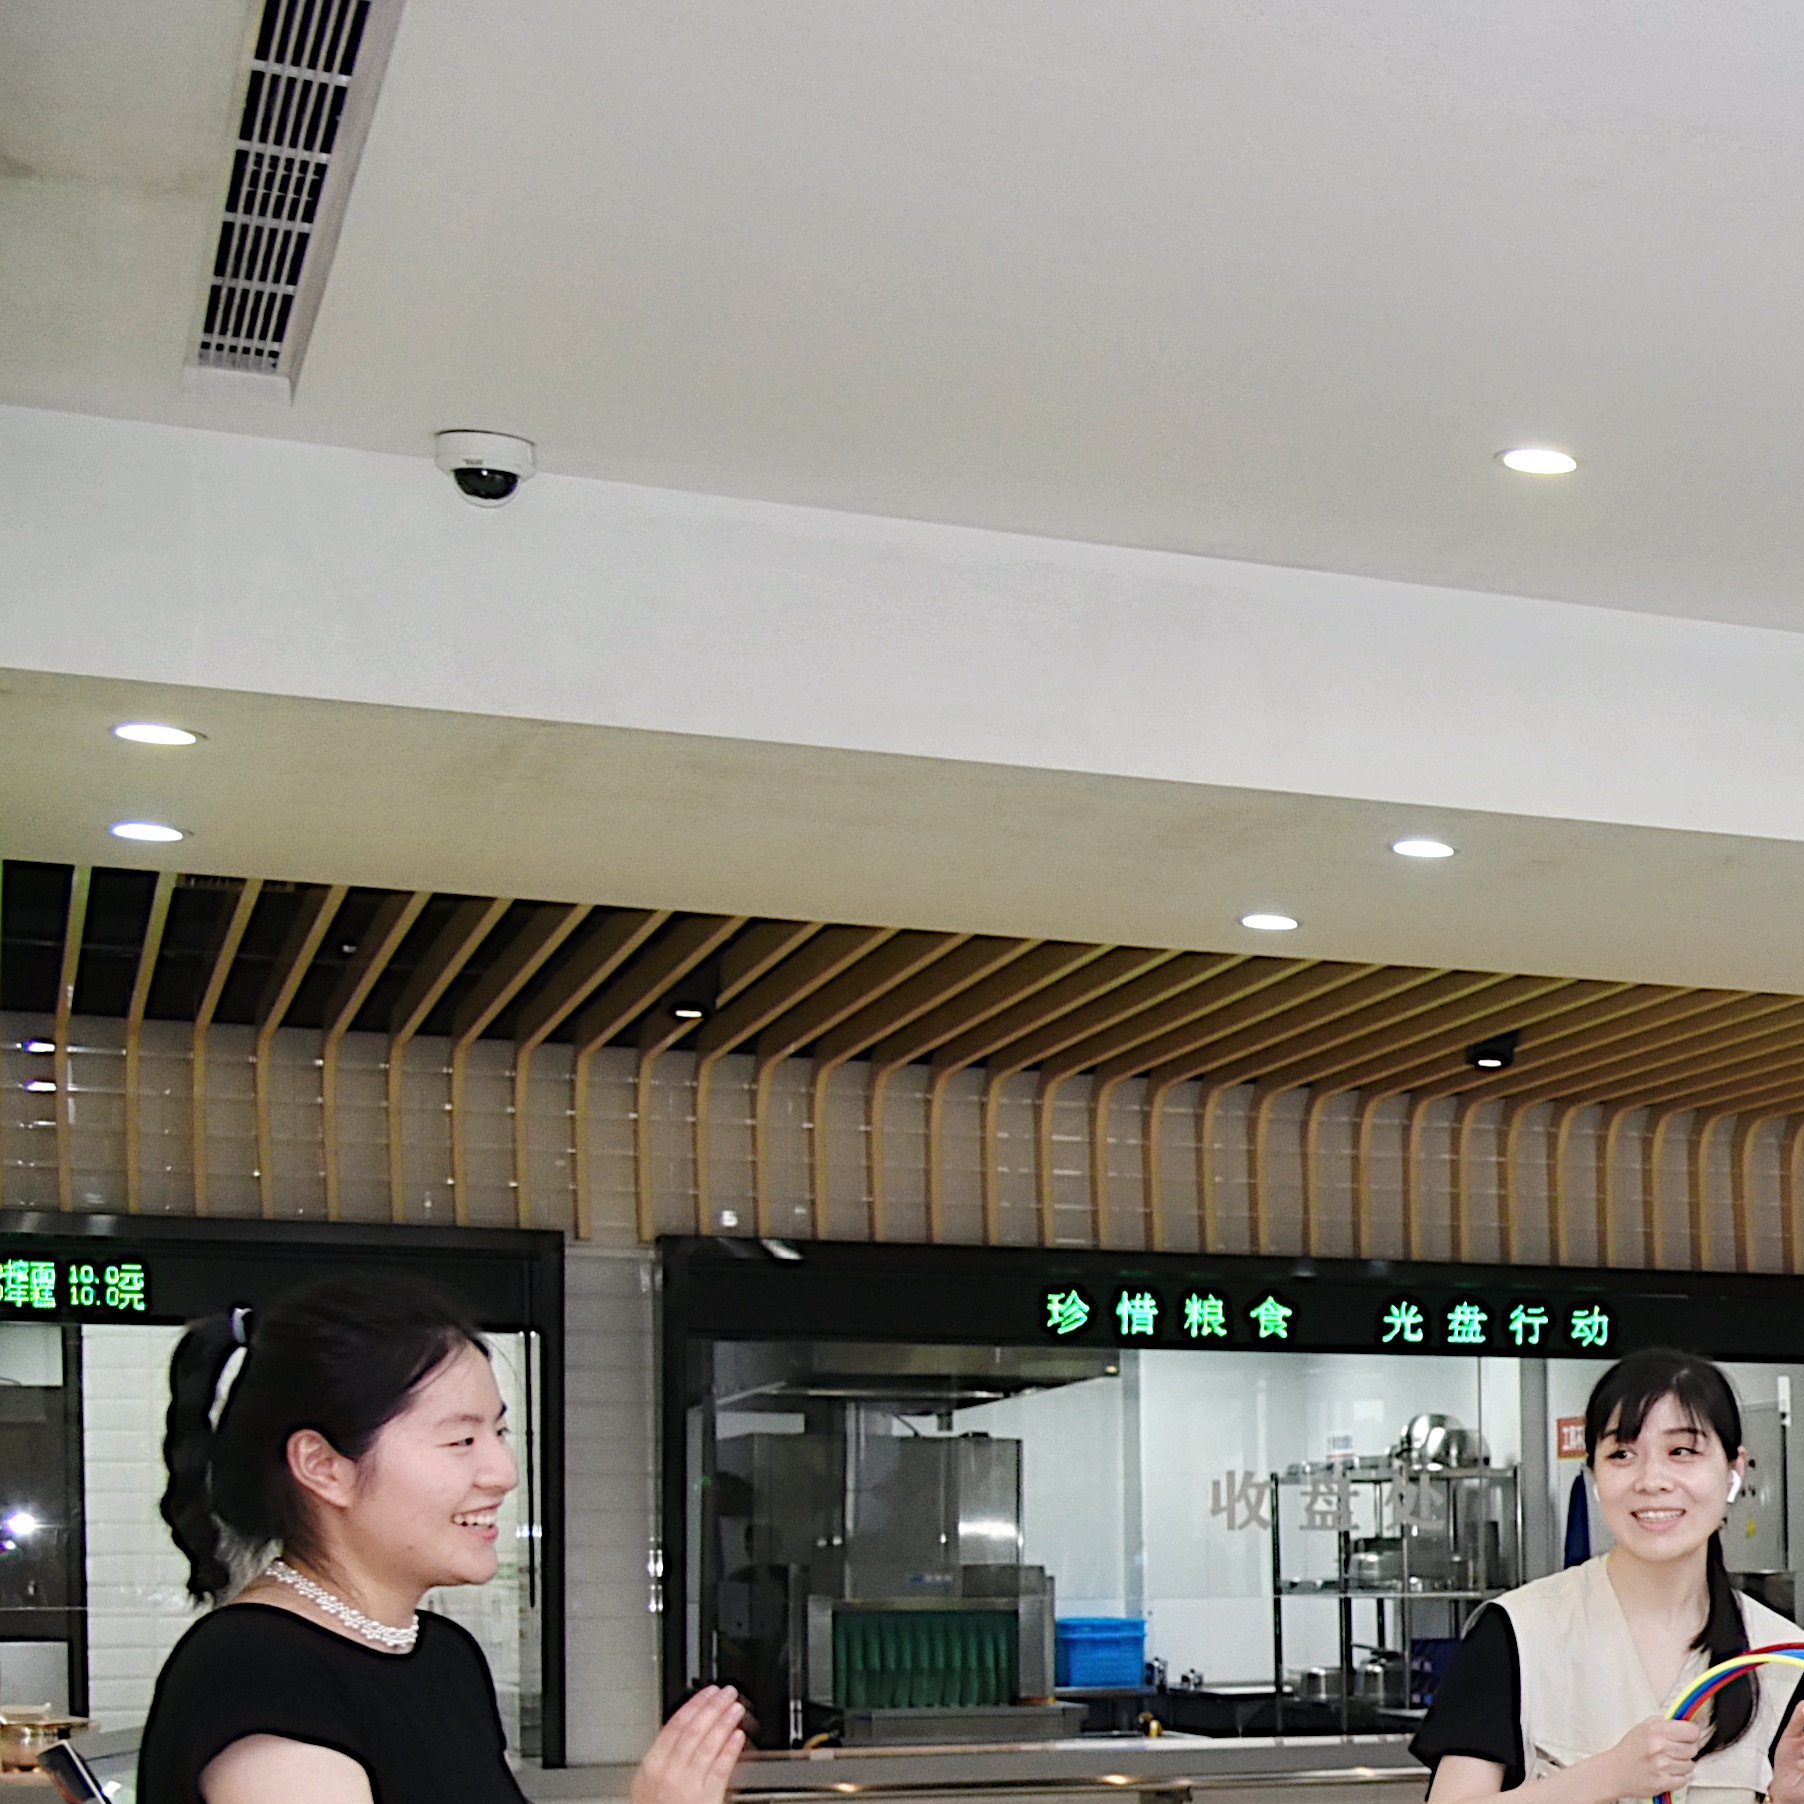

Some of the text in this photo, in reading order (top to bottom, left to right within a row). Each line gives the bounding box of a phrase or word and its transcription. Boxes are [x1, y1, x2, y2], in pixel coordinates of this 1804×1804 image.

[1046, 1289, 1609, 1347] 珍惜粮食 光盘行动
[1210, 1469, 1447, 1532] 收盘处
